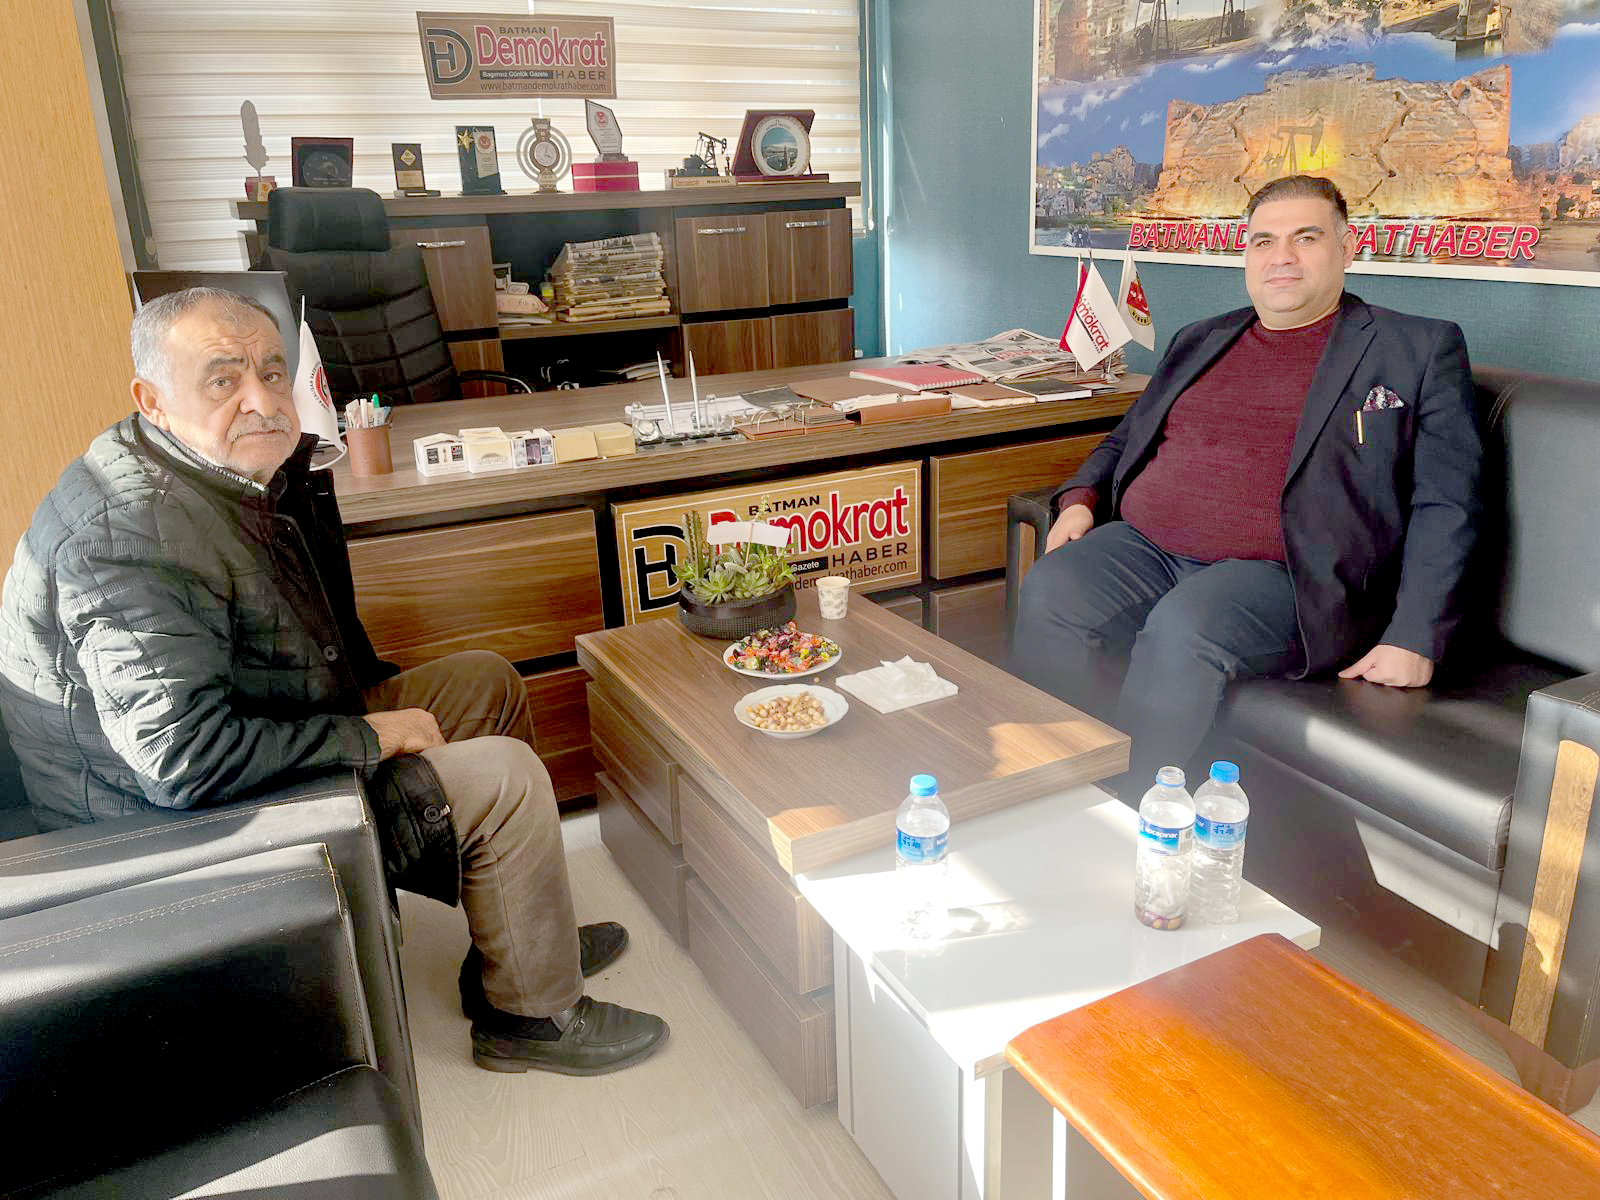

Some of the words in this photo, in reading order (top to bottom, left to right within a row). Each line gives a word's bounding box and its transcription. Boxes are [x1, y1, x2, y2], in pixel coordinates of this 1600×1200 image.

[499, 26, 547, 35] BATMAN
[475, 25, 608, 67] Demokrat
[556, 70, 607, 80] HABER
[1129, 222, 1231, 250] BATMAN
[1407, 223, 1539, 260] HABER
[1076, 298, 1110, 352] mokrat
[790, 560, 820, 573] Gazete
[832, 542, 908, 568] HABER
